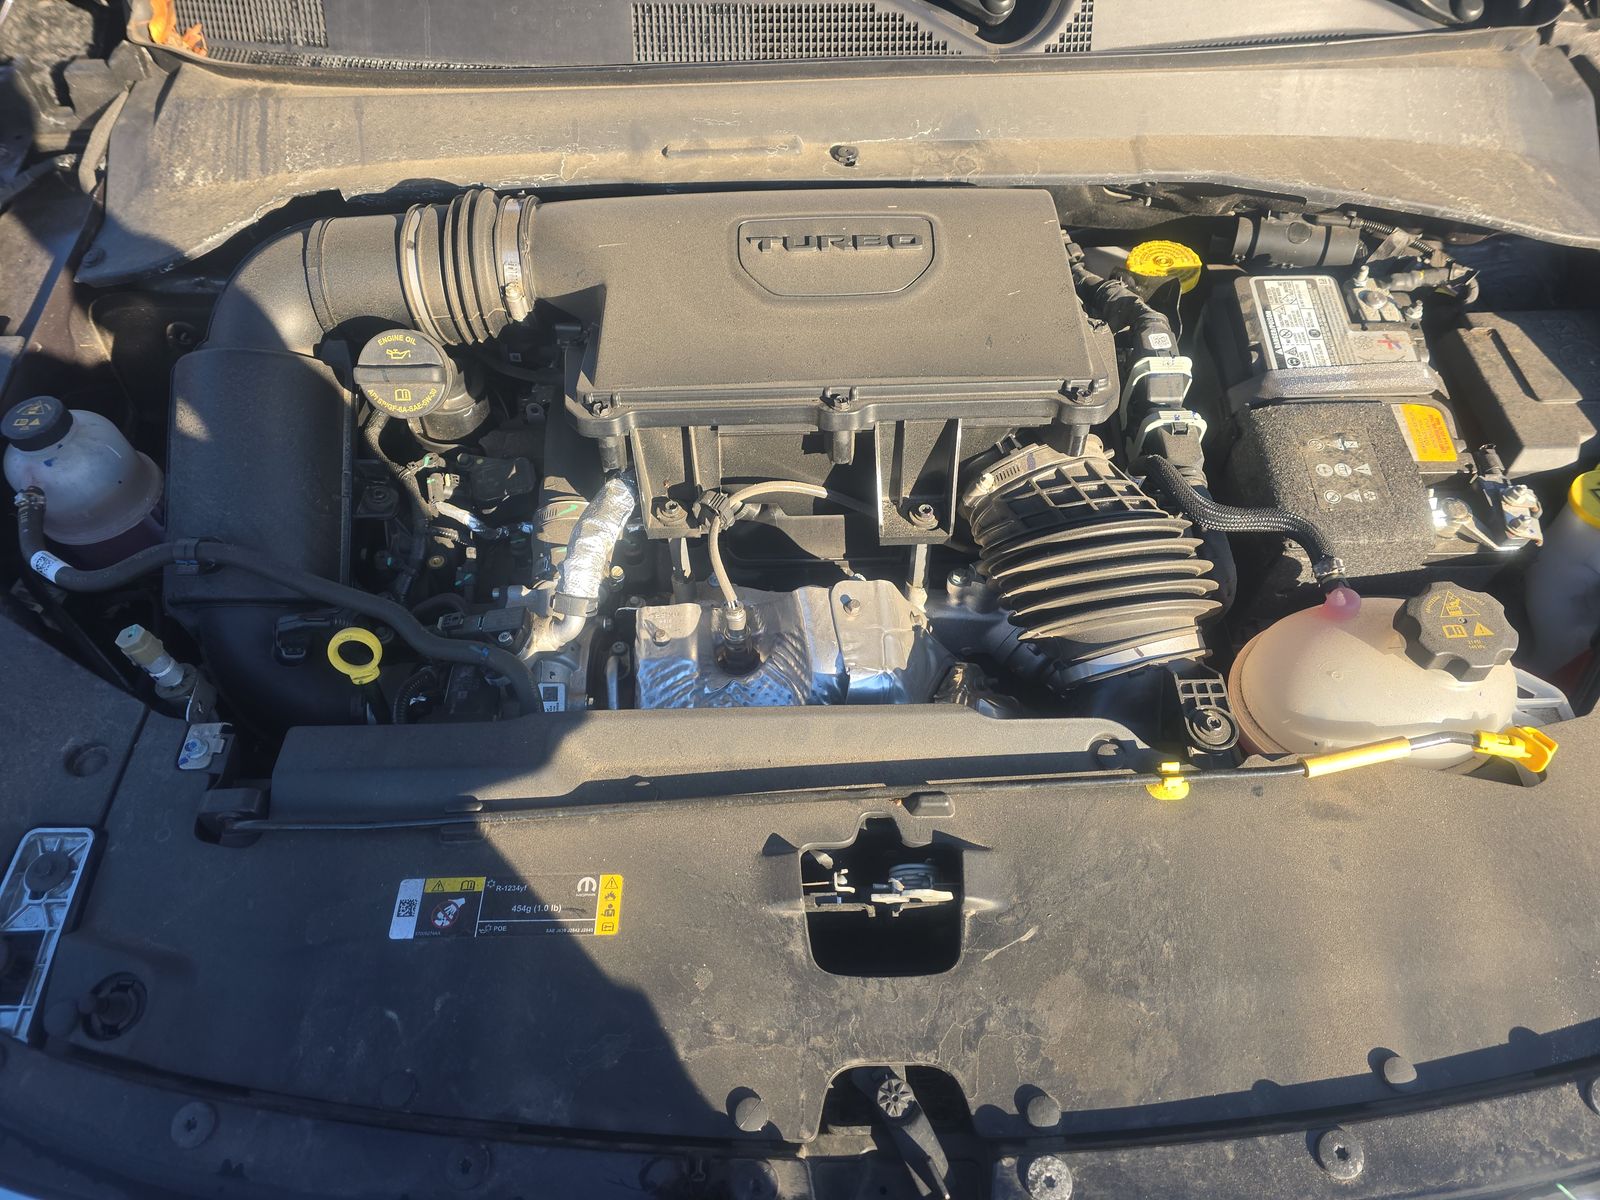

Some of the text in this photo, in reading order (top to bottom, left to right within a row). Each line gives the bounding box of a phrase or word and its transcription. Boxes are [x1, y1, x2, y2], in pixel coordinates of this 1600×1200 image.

[746, 234, 923, 252] TURBO
[377, 334, 417, 346] ENGINE OIL
[495, 884, 527, 893] R-1234yf
[511, 904, 562, 914] 454g (1.0 lb)
